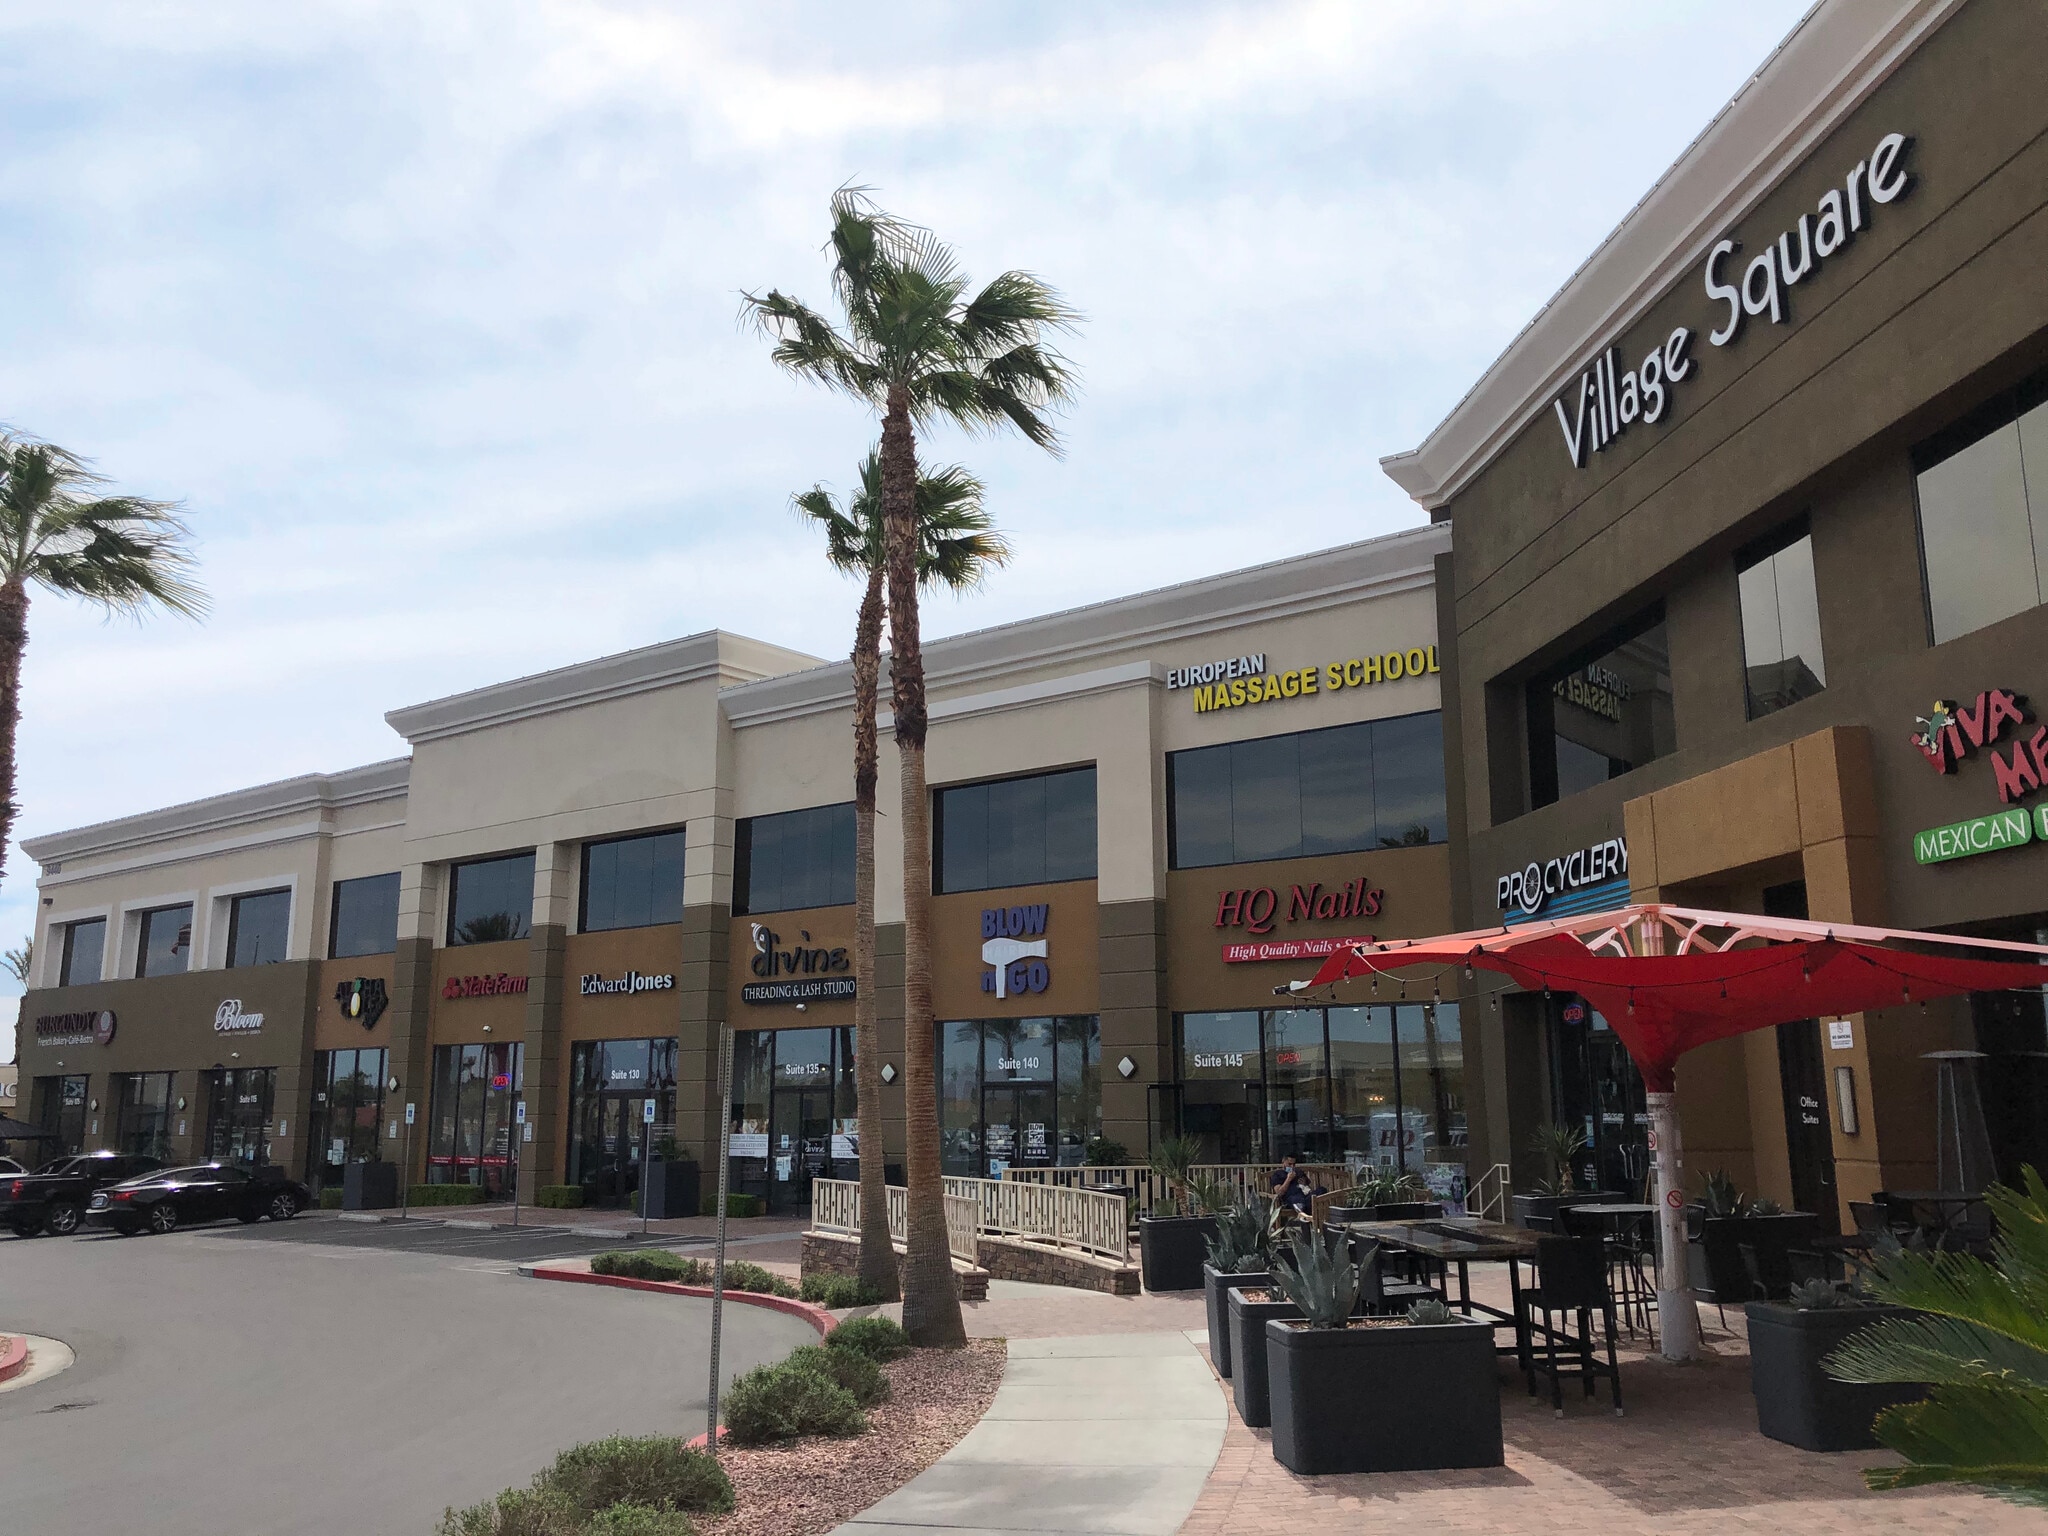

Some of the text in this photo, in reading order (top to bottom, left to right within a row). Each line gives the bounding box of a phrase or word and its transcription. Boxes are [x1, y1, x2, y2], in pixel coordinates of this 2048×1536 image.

[1554, 133, 1910, 468] Village Square
[1167, 653, 1266, 689] EUROPEAN
[1193, 645, 1440, 713] MASSAGE SCHOOL
[1910, 689, 2024, 775] VIVA
[1920, 812, 2026, 861] MEXICAN
[1497, 837, 1628, 914] PRO CYCLERY
[1214, 877, 1384, 934] HQ Nails
[981, 904, 1048, 937] BLOW
[751, 923, 850, 977] divine
[1229, 946, 1256, 960] High
[1260, 943, 1299, 958] Quality
[1303, 941, 1333, 953] Nails
[1007, 961, 1048, 994] GO
[744, 980, 855, 999] THREADING & LASH STUDIO
[36, 1011, 97, 1033] BURGUNDY
[214, 999, 265, 1031] Bloom
[1564, 1006, 1584, 1020] OPEN
[785, 1063, 820, 1075] Suite 135
[998, 1056, 1039, 1070] Suite 140
[1194, 1053, 1243, 1068] Suite 145
[1277, 1052, 1300, 1064] OPEN
[611, 1069, 640, 1080] Suite 130
[240, 1095, 250, 1103] Suite
[1800, 1096, 1818, 1108] Office
[1802, 1113, 1819, 1124] Suites
